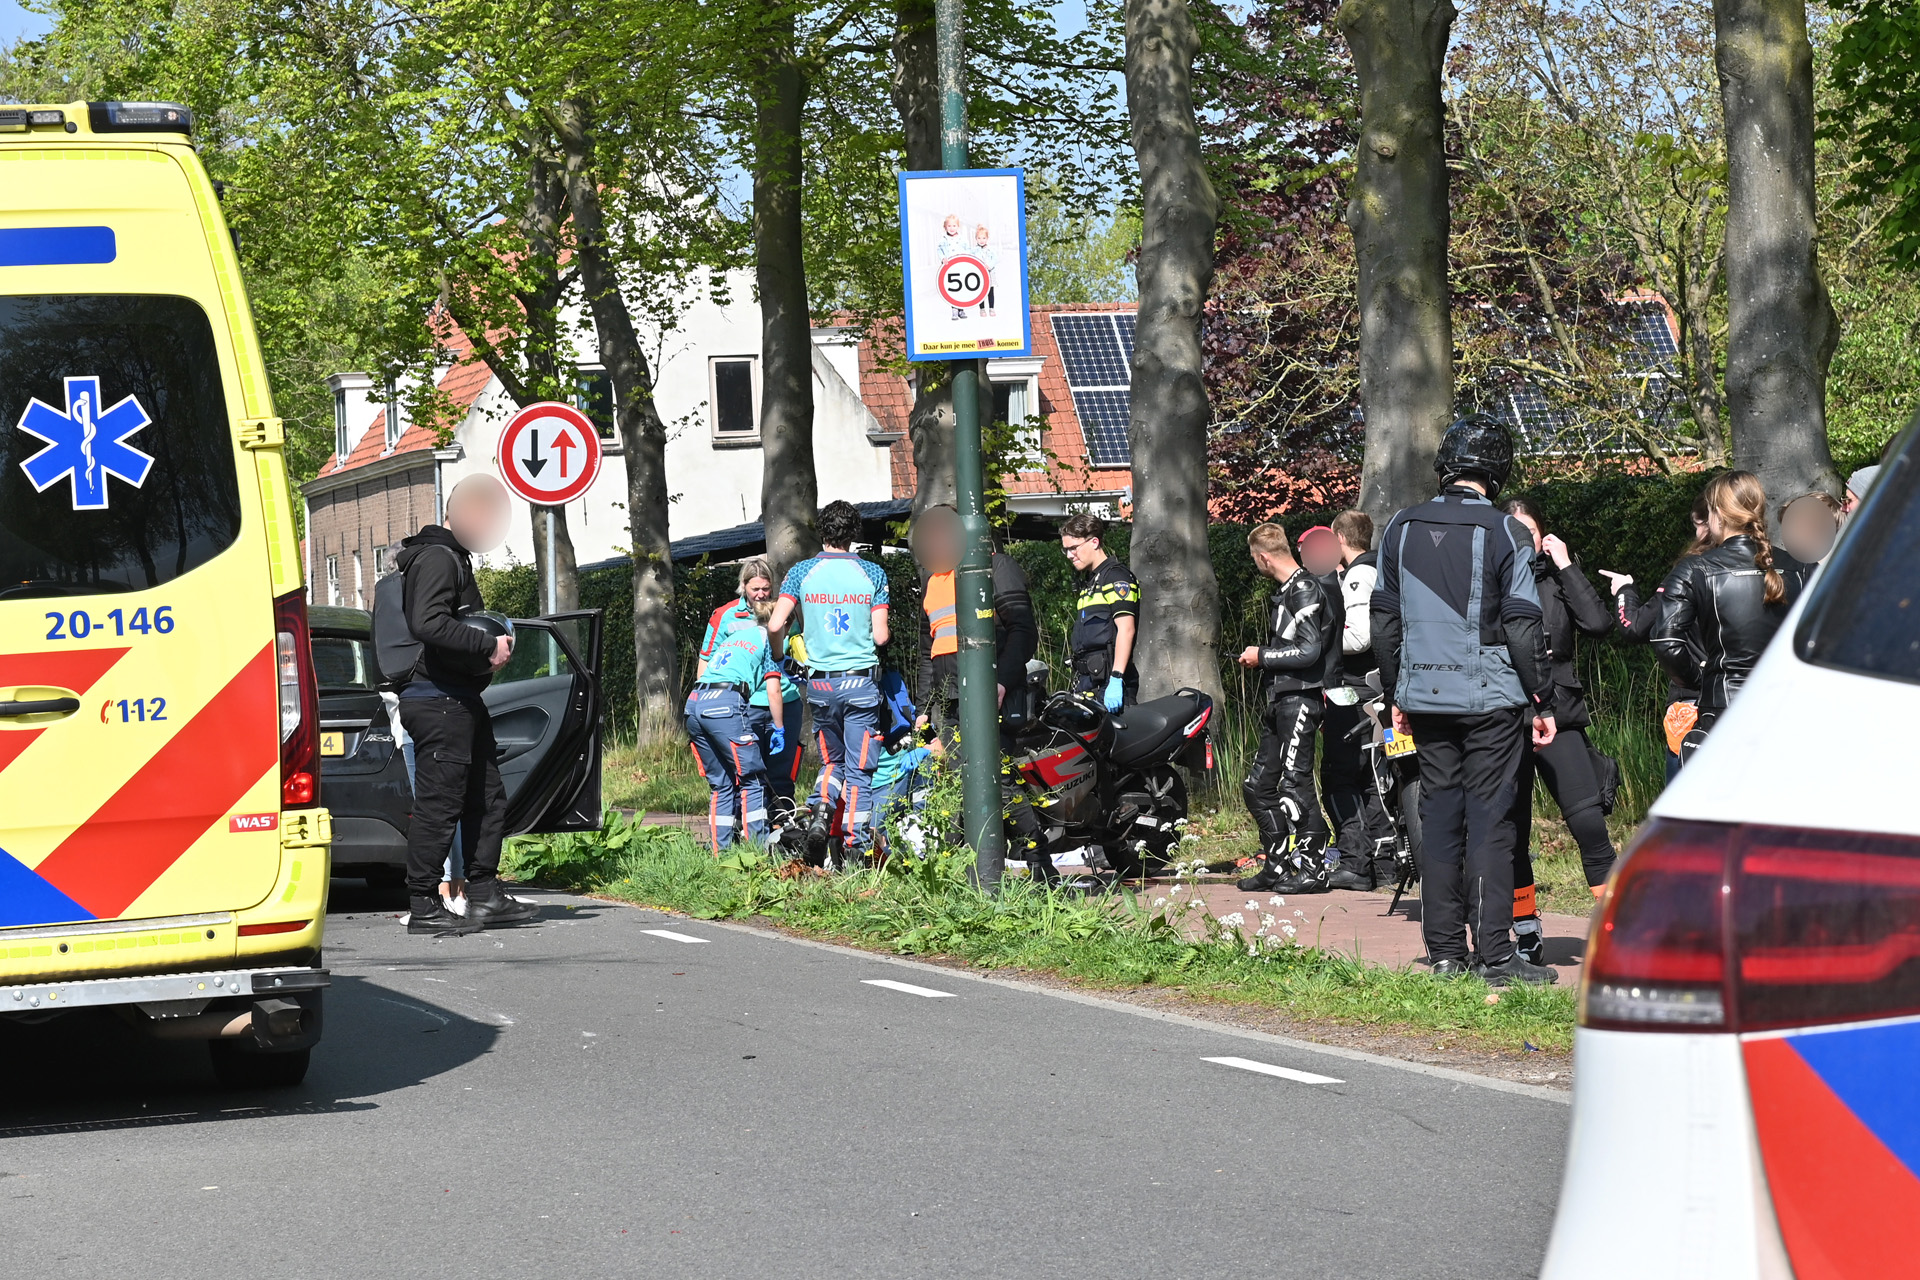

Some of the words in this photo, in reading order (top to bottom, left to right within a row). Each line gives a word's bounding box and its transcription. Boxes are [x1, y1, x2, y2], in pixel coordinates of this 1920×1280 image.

[948, 272, 981, 292] 50
[953, 342, 960, 350] je
[804, 593, 872, 604] AMBULANCE
[45, 606, 174, 640] 20-146
[1412, 663, 1463, 672] DAINESE
[116, 697, 168, 723] 1-1-2
[1059, 769, 1095, 794] SUZUKI
